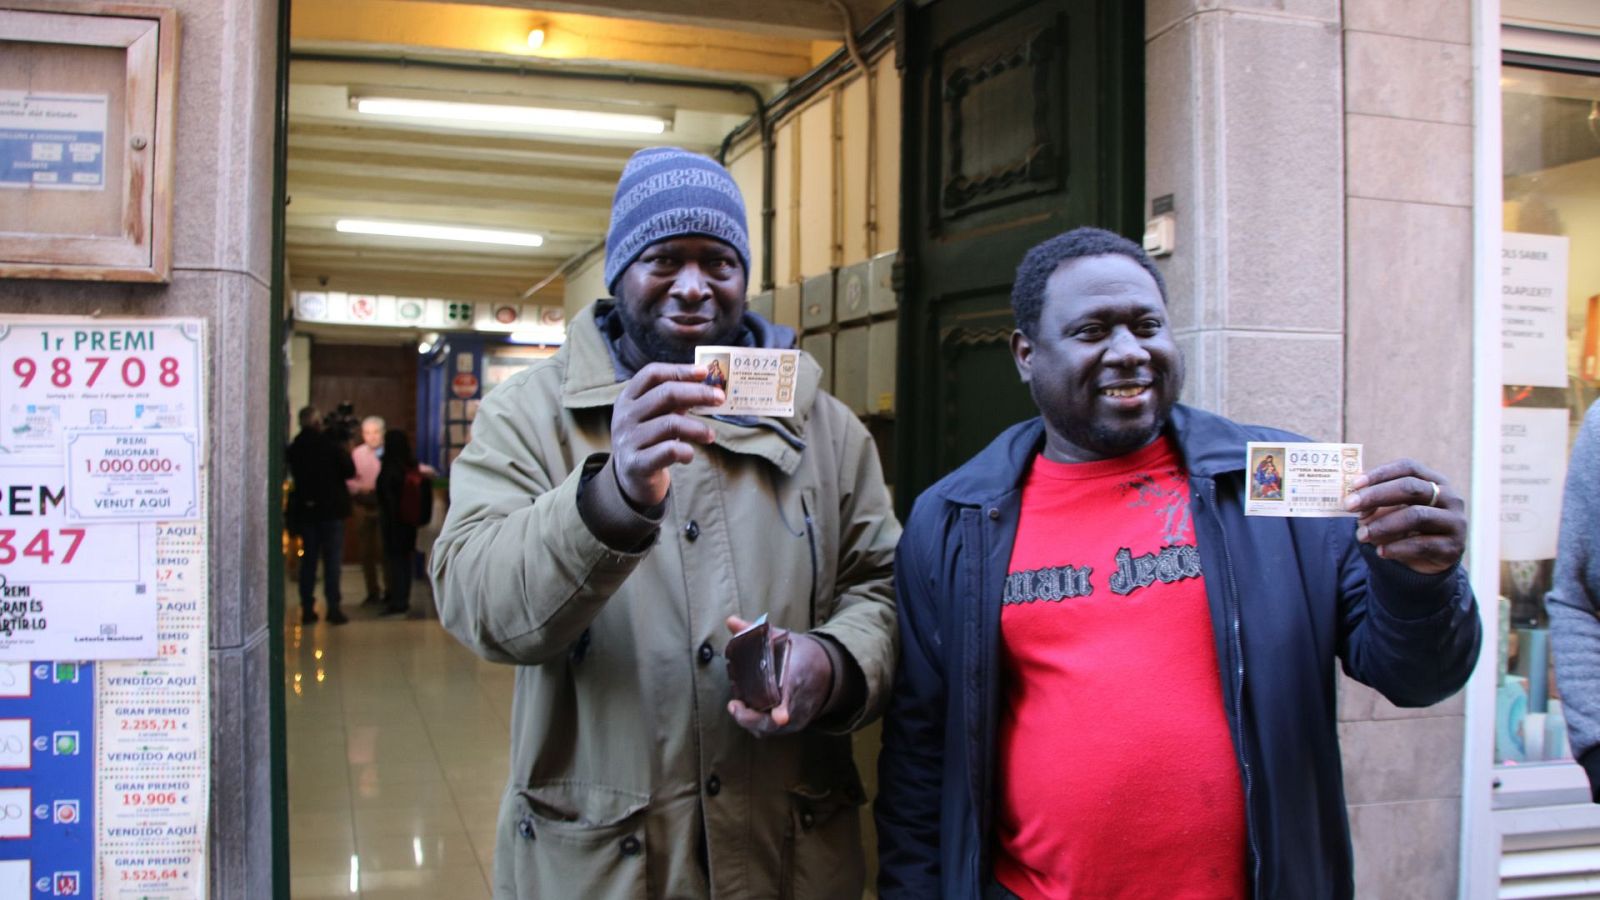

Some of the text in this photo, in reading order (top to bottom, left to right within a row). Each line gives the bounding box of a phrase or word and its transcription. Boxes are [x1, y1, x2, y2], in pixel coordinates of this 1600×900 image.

[74, 331, 154, 351] PREMI
[734, 357, 778, 369] 04074
[13, 357, 180, 389] 98708
[116, 437, 147, 445] PREMI
[104, 448, 159, 457] MILIONARI
[1290, 452, 1340, 464] 04074
[85, 458, 172, 473] 1.000.000
[94, 498, 135, 508] VENUT
[108, 677, 163, 686] VENDIDO
[115, 706, 190, 716] GRAN PREMIO
[108, 752, 163, 761] VENDIDO
[115, 781, 190, 791] GRAN PREMIO
[122, 793, 177, 806] 19.906
[108, 827, 163, 837] VENDIDO
[115, 856, 191, 866] GRAN PREMIO
